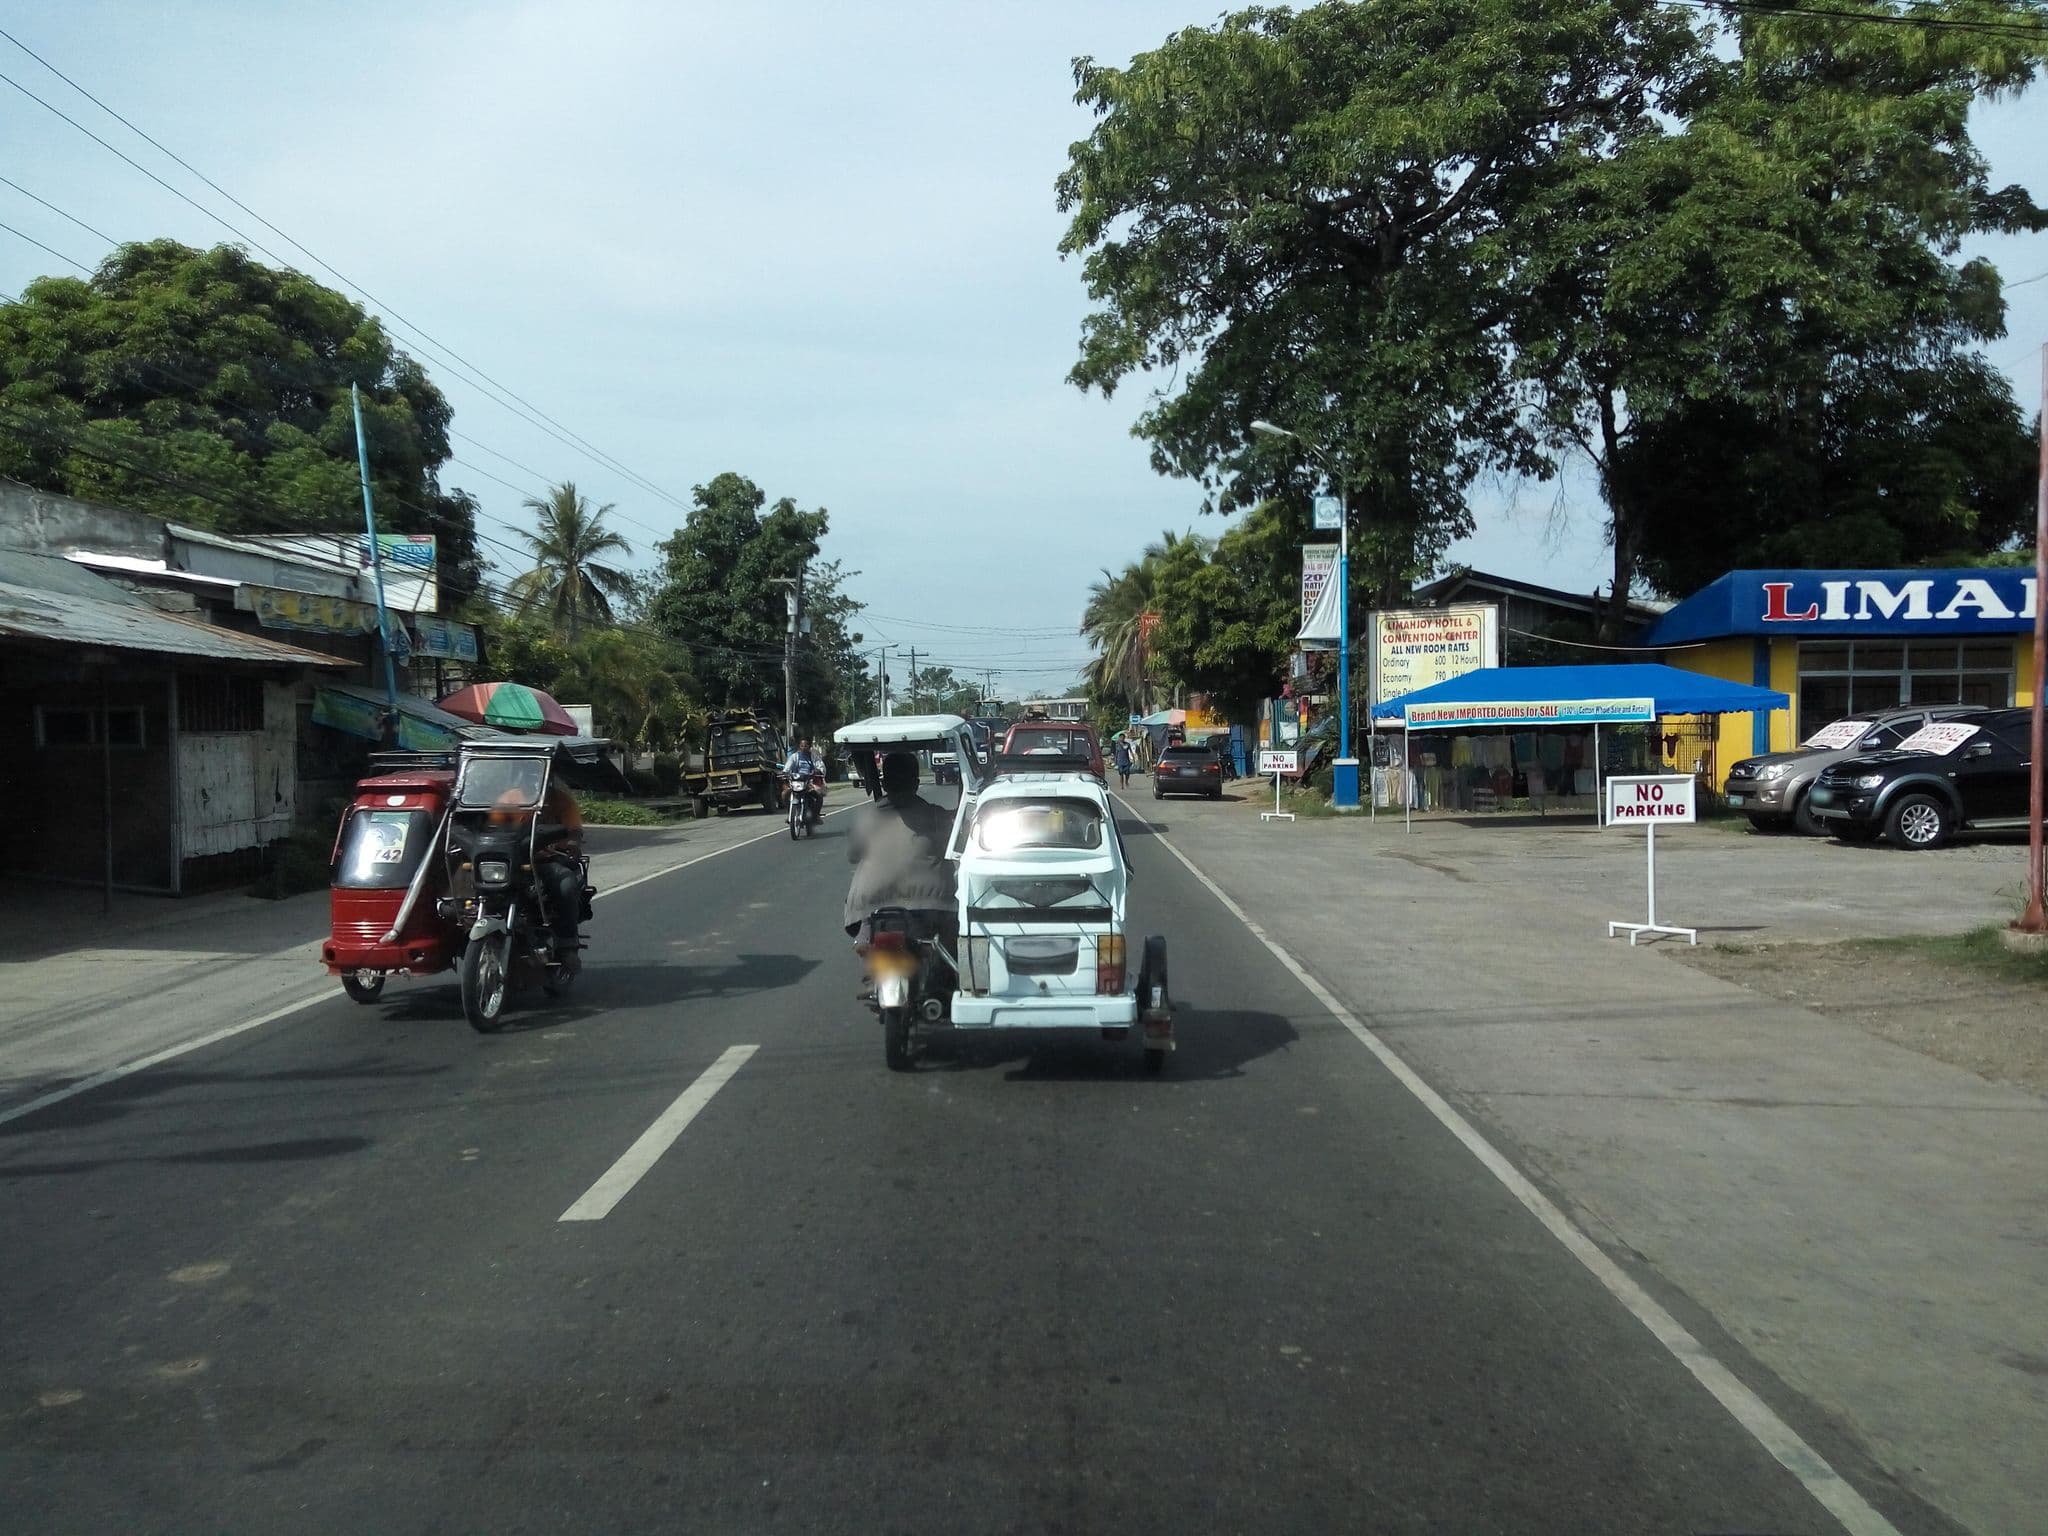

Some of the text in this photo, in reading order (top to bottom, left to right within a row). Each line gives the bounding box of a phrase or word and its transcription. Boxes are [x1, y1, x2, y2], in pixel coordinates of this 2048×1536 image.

[1387, 618, 1472, 630] LIMAHJOY HOTEL &
[1382, 631, 1479, 644] CONVENTION CENTER
[1391, 643, 1469, 655] ALL NEW ROOM RATES
[1382, 655, 1479, 668] Ordinary 600 12 Hours
[1383, 674, 1412, 684] Economy
[1435, 671, 1447, 681] 790
[1411, 705, 1558, 722] Brand New IMPORTED Cloths for SALE
[1272, 754, 1285, 763] NO
[1636, 783, 1664, 802] NO
[1615, 804, 1685, 817] PARKING
